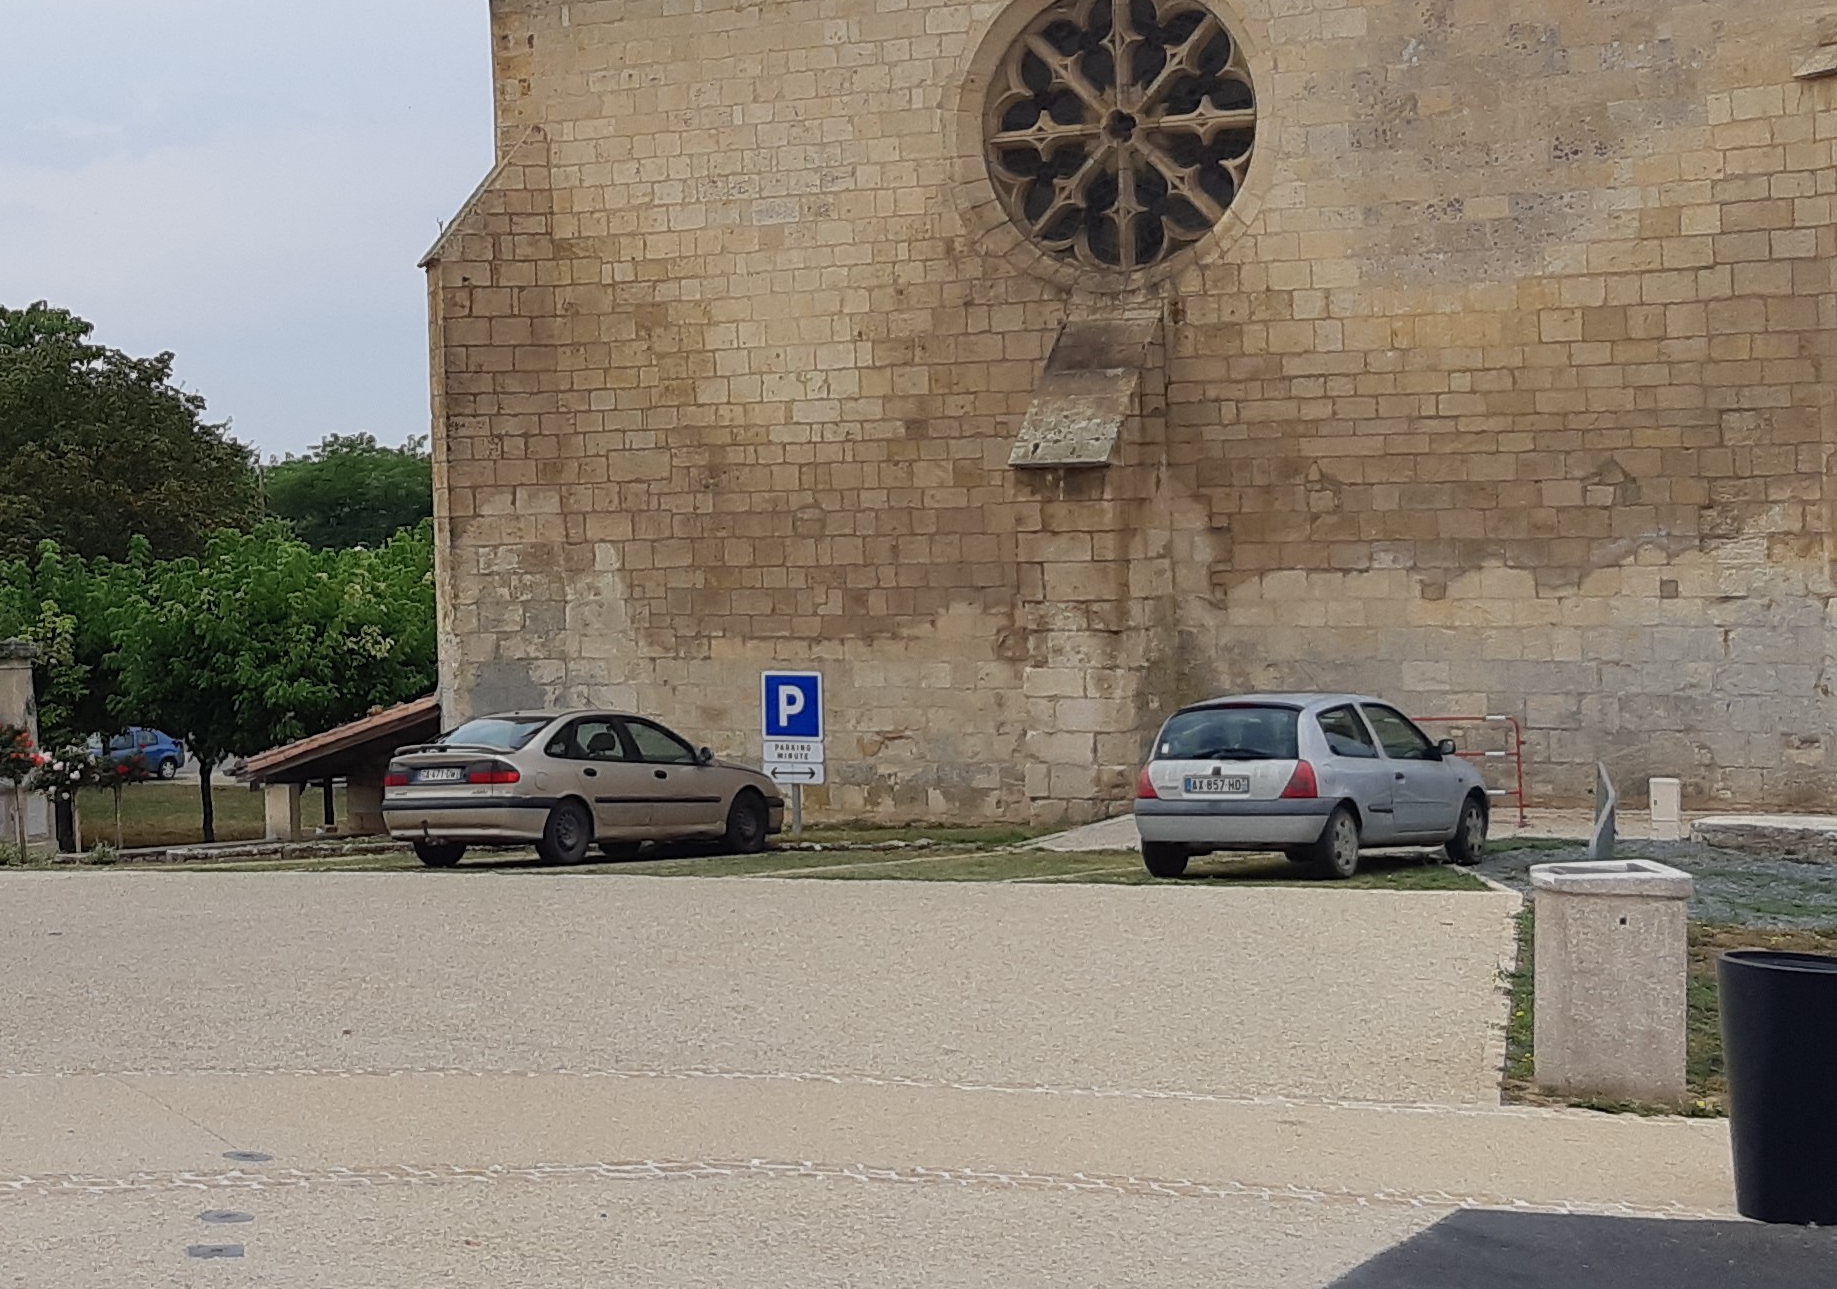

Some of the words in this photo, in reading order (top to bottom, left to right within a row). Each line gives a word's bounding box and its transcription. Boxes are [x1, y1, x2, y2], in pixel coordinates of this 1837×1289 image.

[778, 685, 805, 727] P
[775, 743, 812, 752] PARKING
[777, 753, 809, 761] MINUTE
